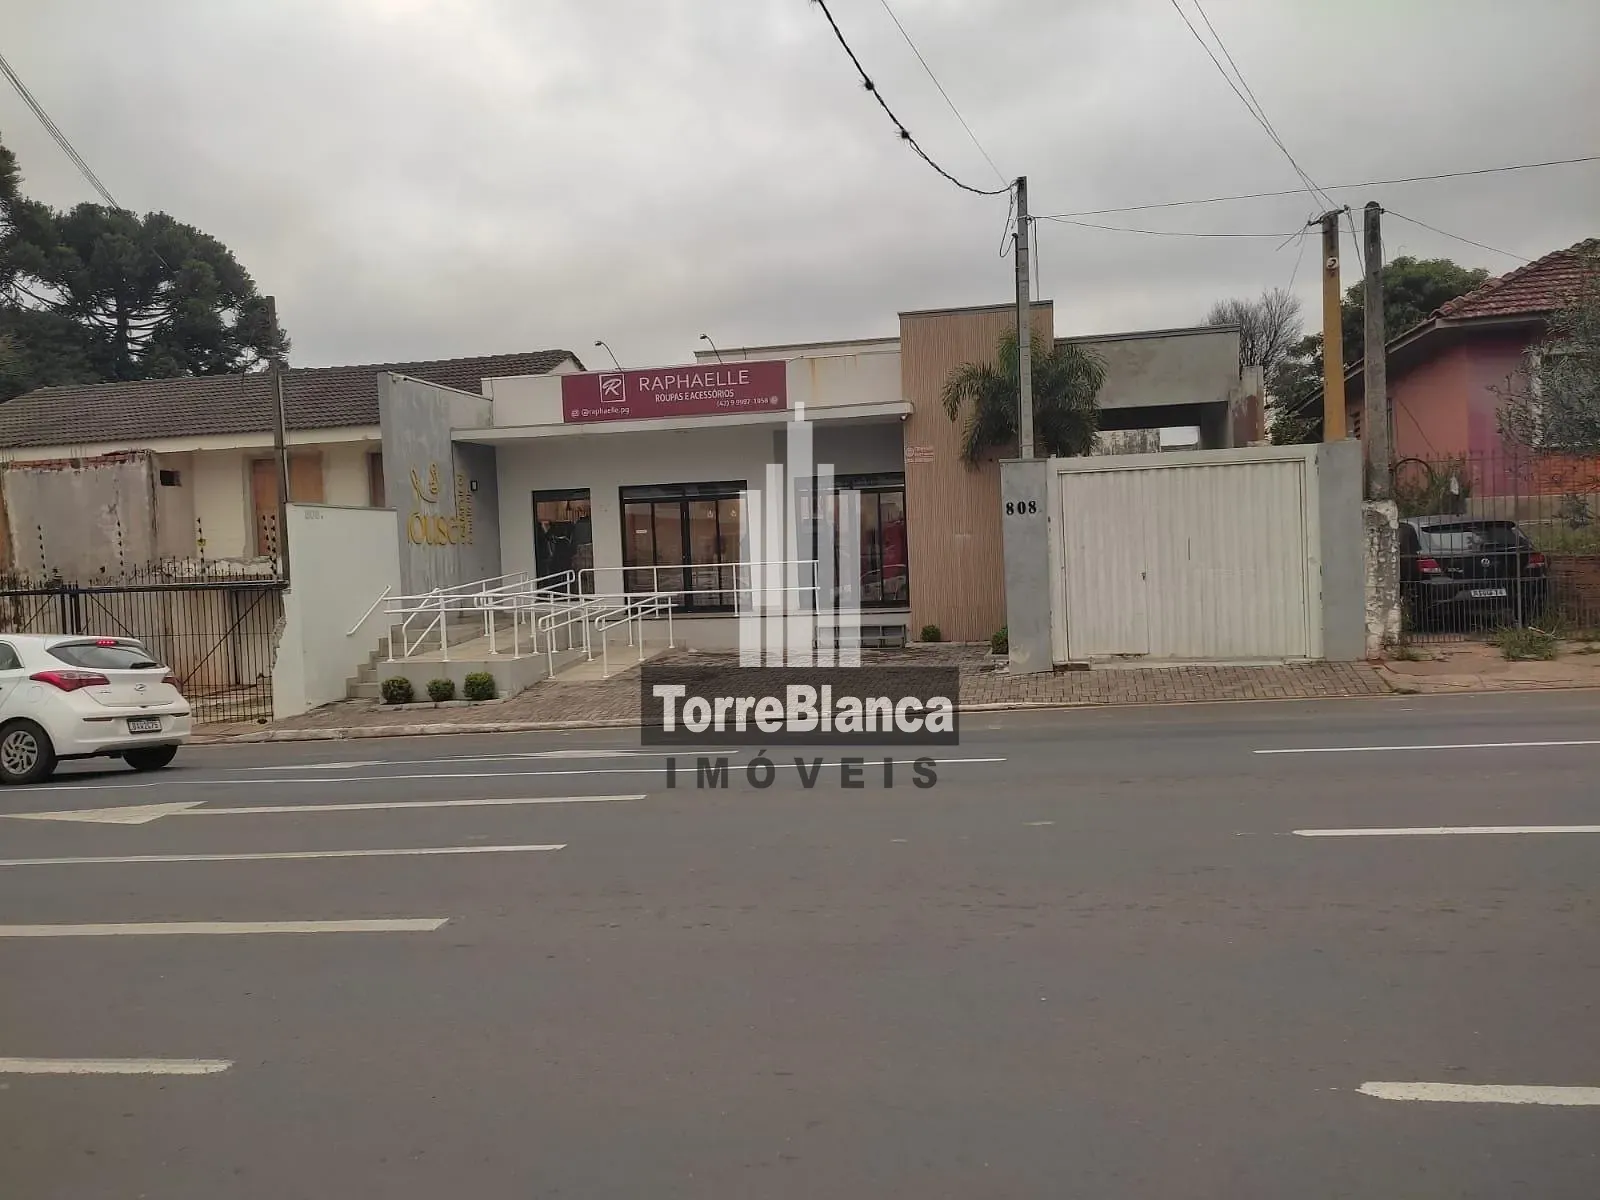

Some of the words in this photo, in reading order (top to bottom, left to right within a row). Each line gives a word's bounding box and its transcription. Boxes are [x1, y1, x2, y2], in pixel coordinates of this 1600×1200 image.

[639, 370, 750, 392] RAPHAELLE
[655, 392, 684, 403] ROUPAS
[690, 388, 735, 400] ACESSÓRIOS
[1006, 501, 1037, 515] 808
